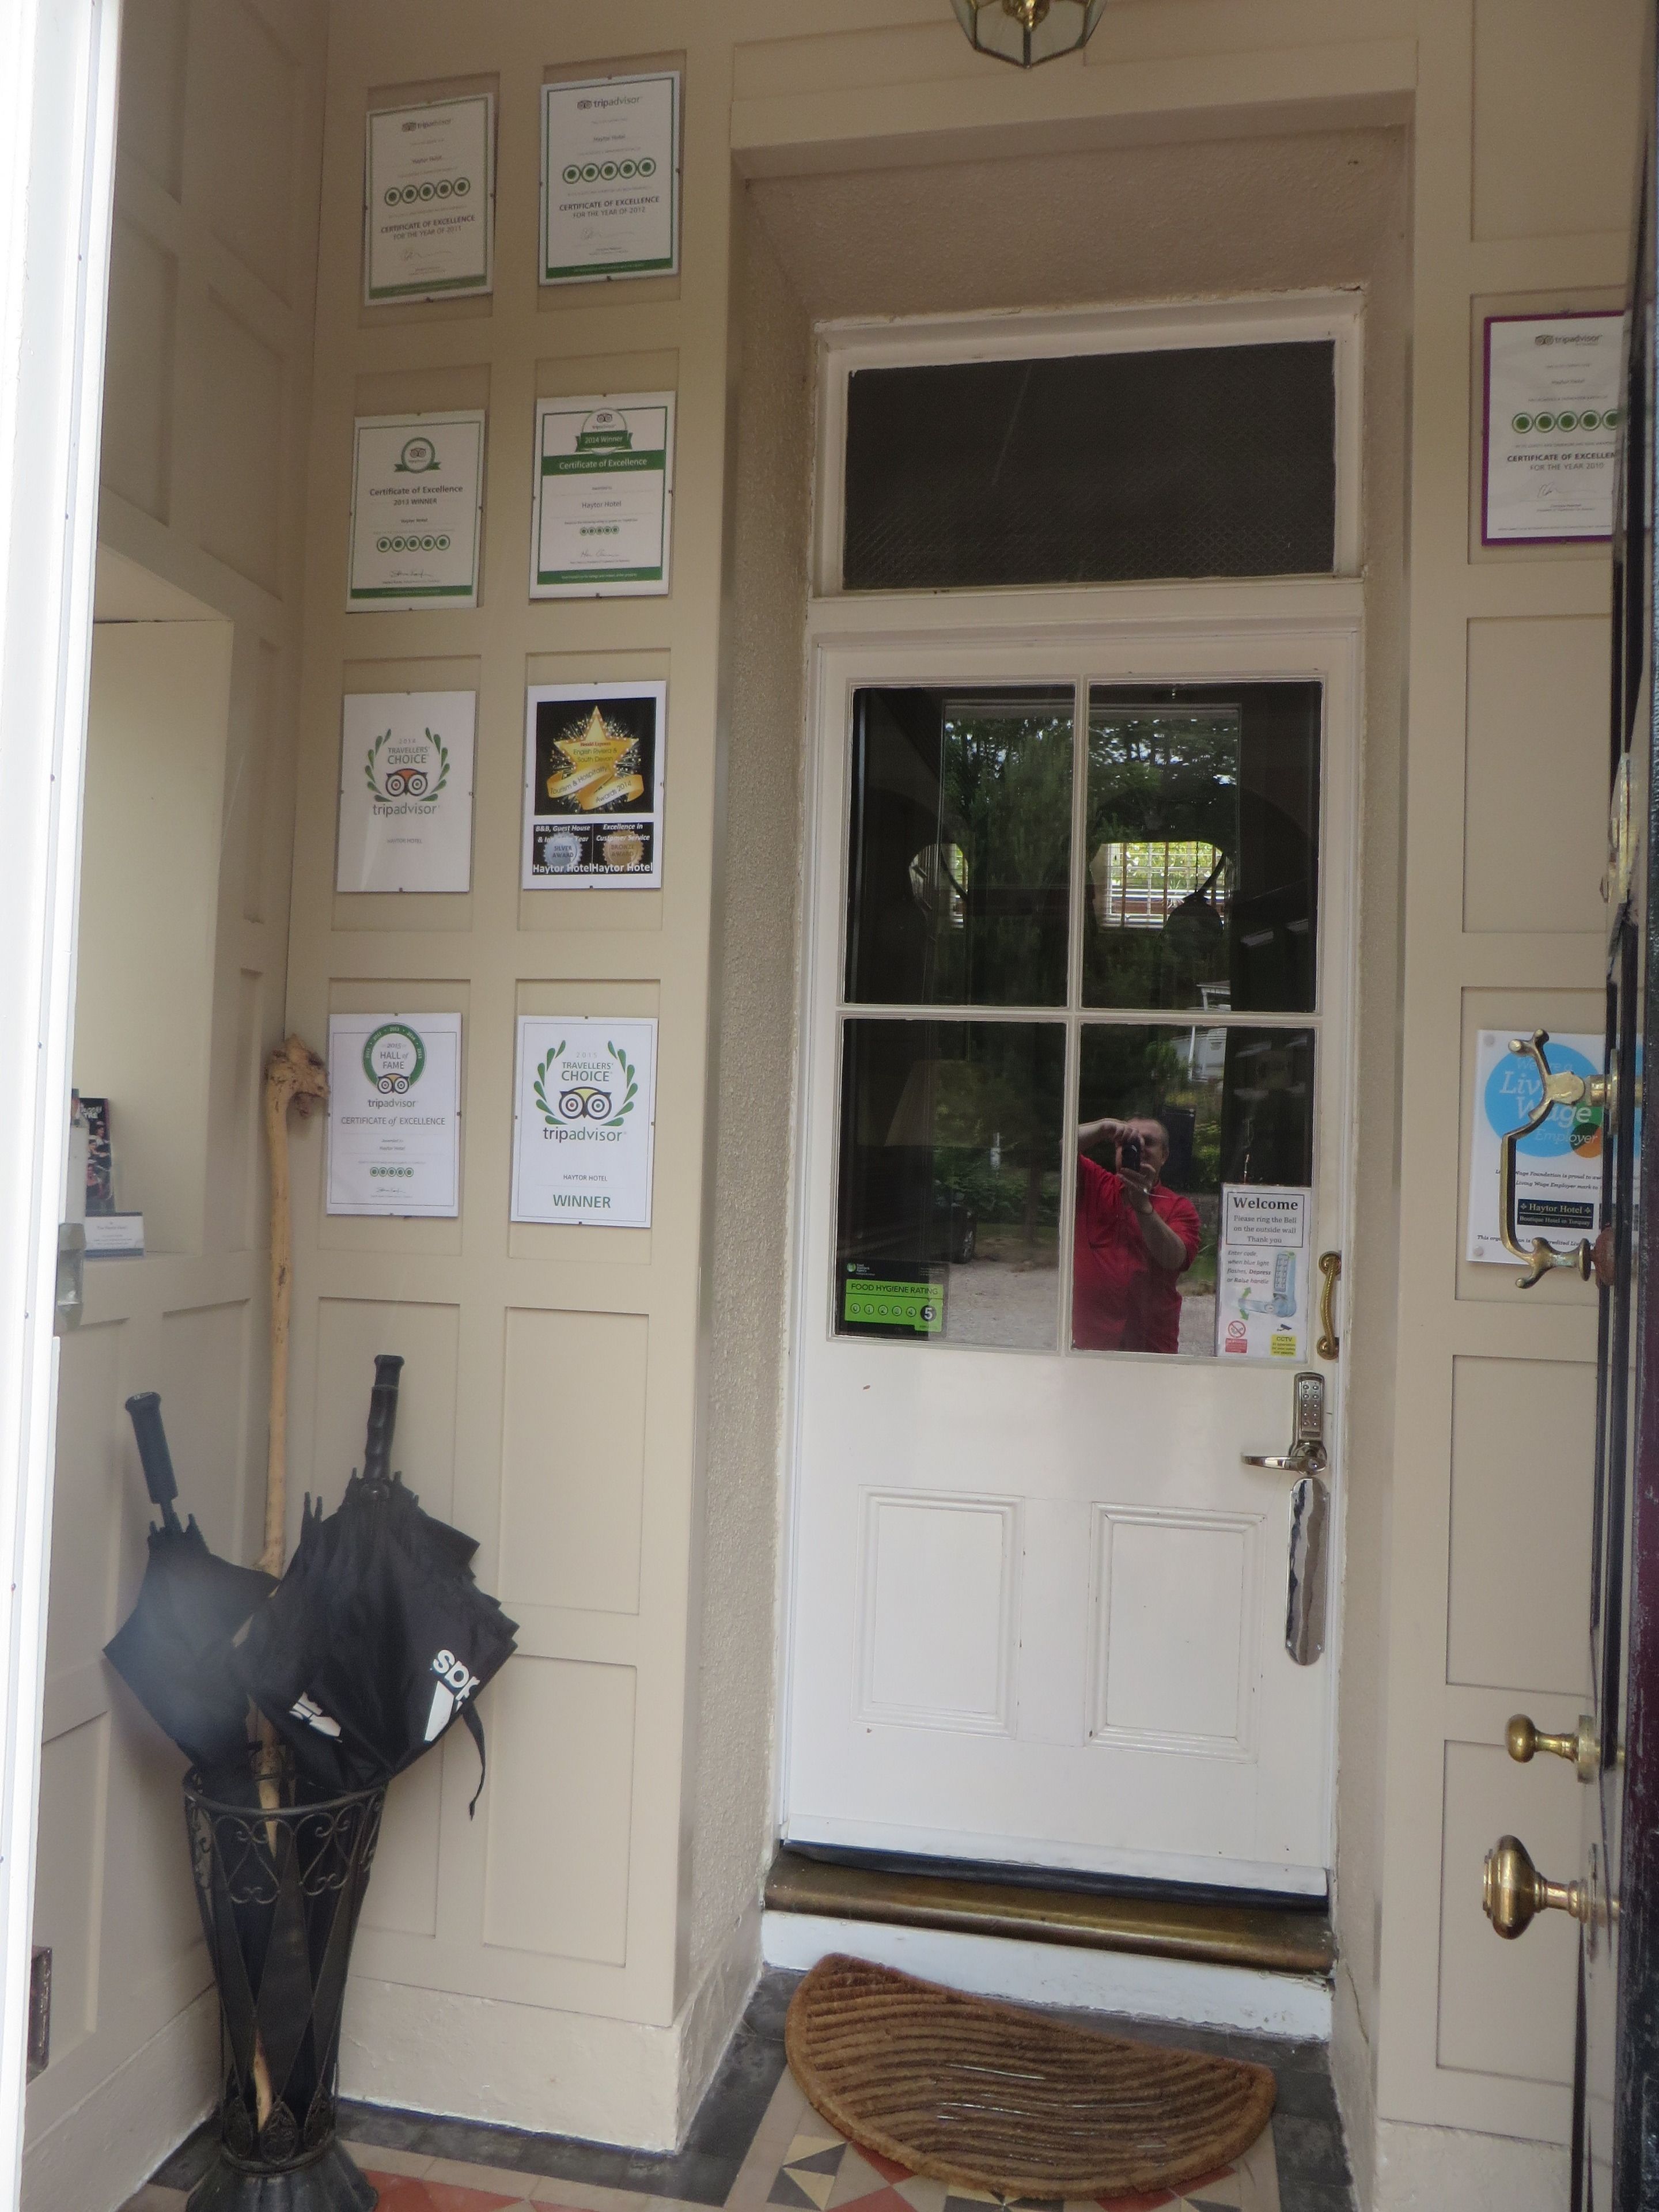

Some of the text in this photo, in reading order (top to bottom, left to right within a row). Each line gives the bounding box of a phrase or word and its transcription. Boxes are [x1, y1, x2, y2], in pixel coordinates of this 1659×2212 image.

[594, 96, 641, 108] tripadvisor
[559, 202, 601, 211] CERTIFICATE
[616, 196, 660, 206] EXCELLENCE
[381, 222, 421, 233] CERTIFICATE
[433, 215, 476, 226] EXCELLENCE
[559, 461, 597, 469] Certificate
[609, 458, 647, 467] Excellence
[1507, 453, 1558, 462] CERTIFICATE
[369, 487, 410, 496] Certificate
[423, 484, 463, 494] Excellence
[582, 501, 603, 509] Haytor
[388, 754, 427, 764] CHOICE
[578, 764, 611, 783] Hospitality
[596, 790, 616, 803] Awards
[373, 802, 438, 817] tripadvisor
[533, 863, 592, 874] Haytor Hotel
[592, 862, 653, 874] Haytor Hotel
[380, 1051, 402, 1060] HALL
[383, 1062, 404, 1070] FAME
[562, 1070, 610, 1082] CHOICE
[368, 1099, 416, 1109] tripadvisor
[341, 1117, 387, 1125] CERTIFICATE
[388, 1116, 397, 1126] of
[543, 1127, 623, 1143] tripadvisor
[1535, 1129, 1599, 1144] Employer
[553, 1194, 611, 1208] WINNER
[1233, 1196, 1298, 1210] Welcome
[1529, 1203, 1582, 1214] Haytor Hotel
[876, 1285, 909, 1293] HYGIENE
[911, 1287, 938, 1295] RATING
[924, 1307, 933, 1320] 5
